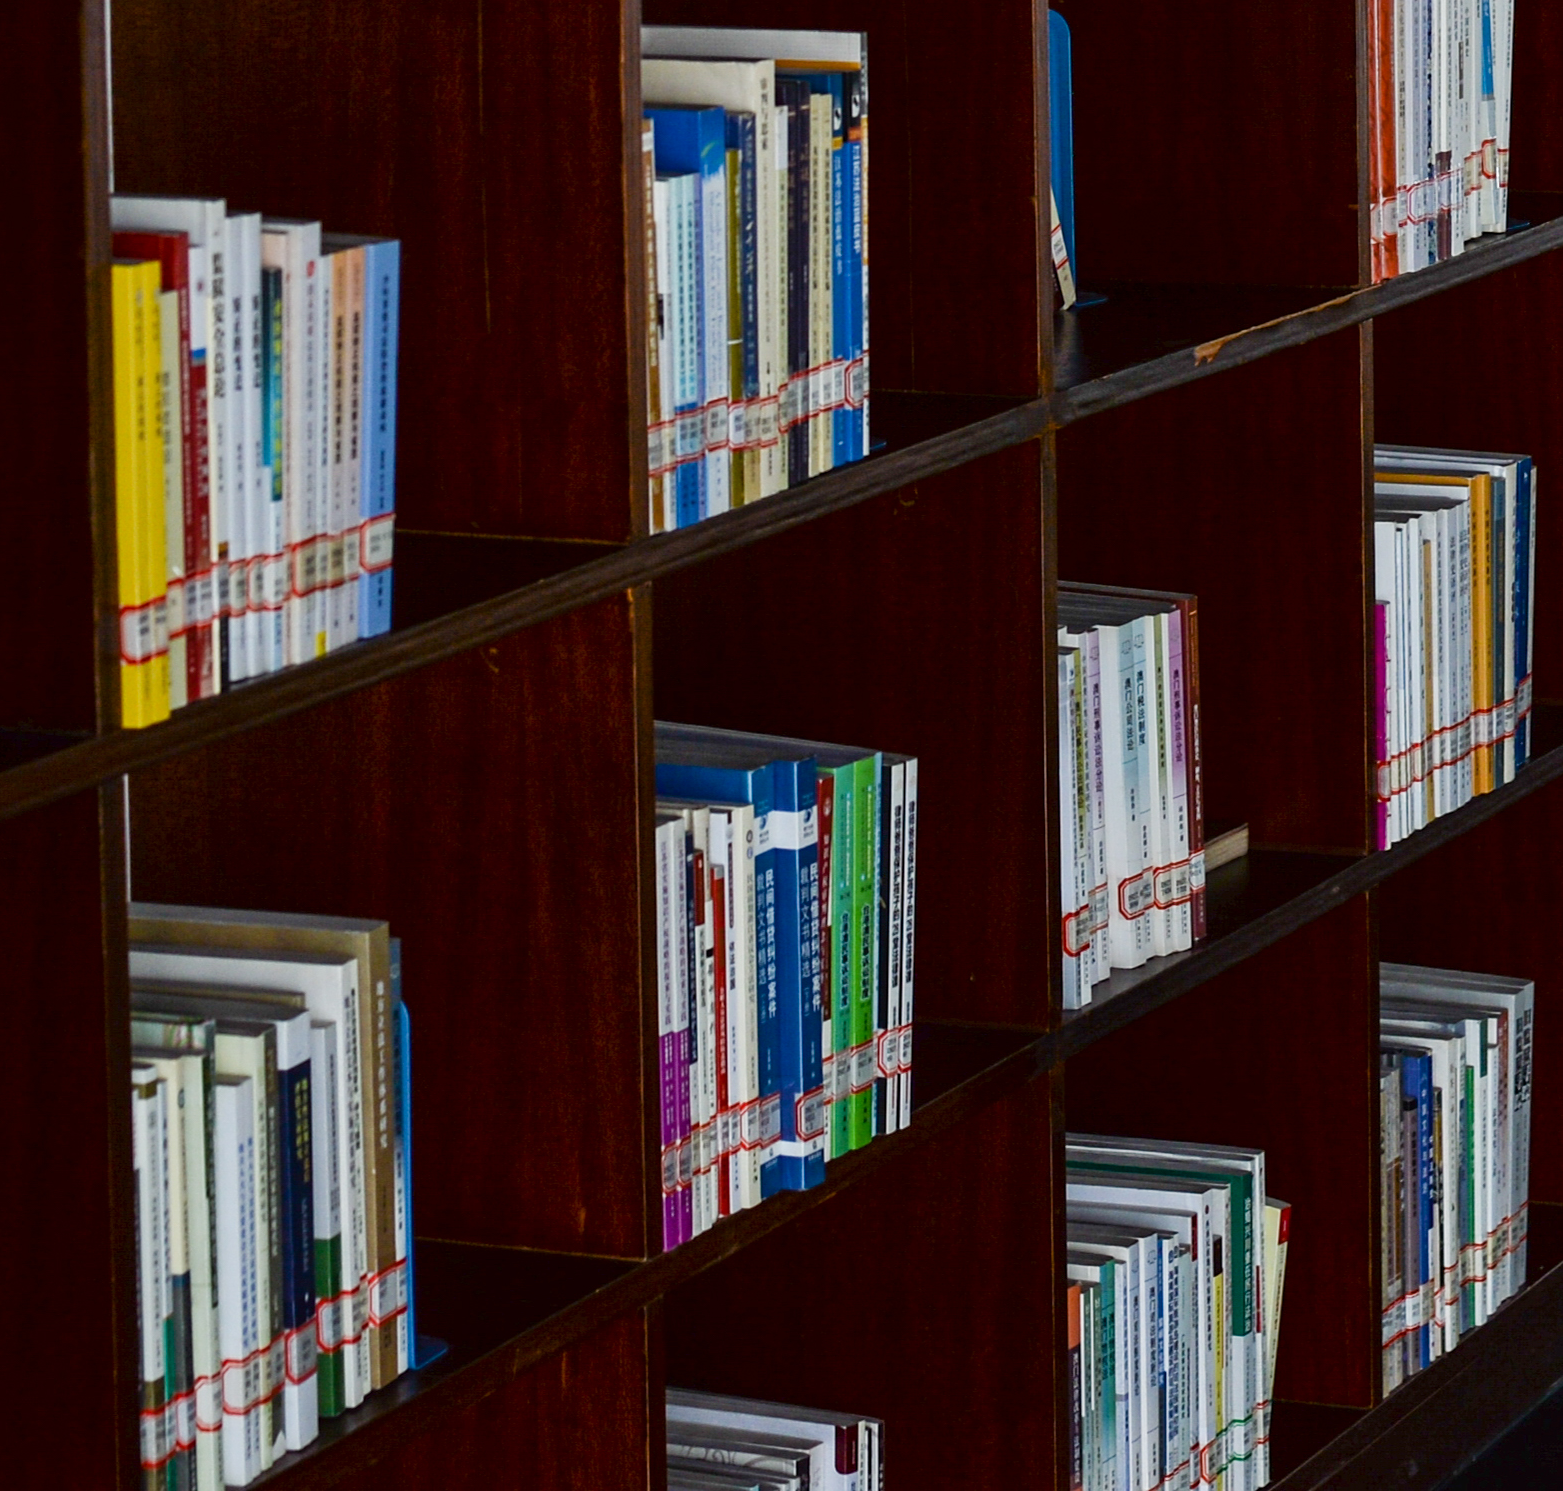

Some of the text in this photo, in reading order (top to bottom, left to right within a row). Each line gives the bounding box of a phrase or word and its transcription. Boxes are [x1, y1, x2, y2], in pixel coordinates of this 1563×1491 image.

[765, 868, 776, 1018] 民间借贷纠纷案件
[810, 862, 820, 1012] 民间借贷纠纷案件
